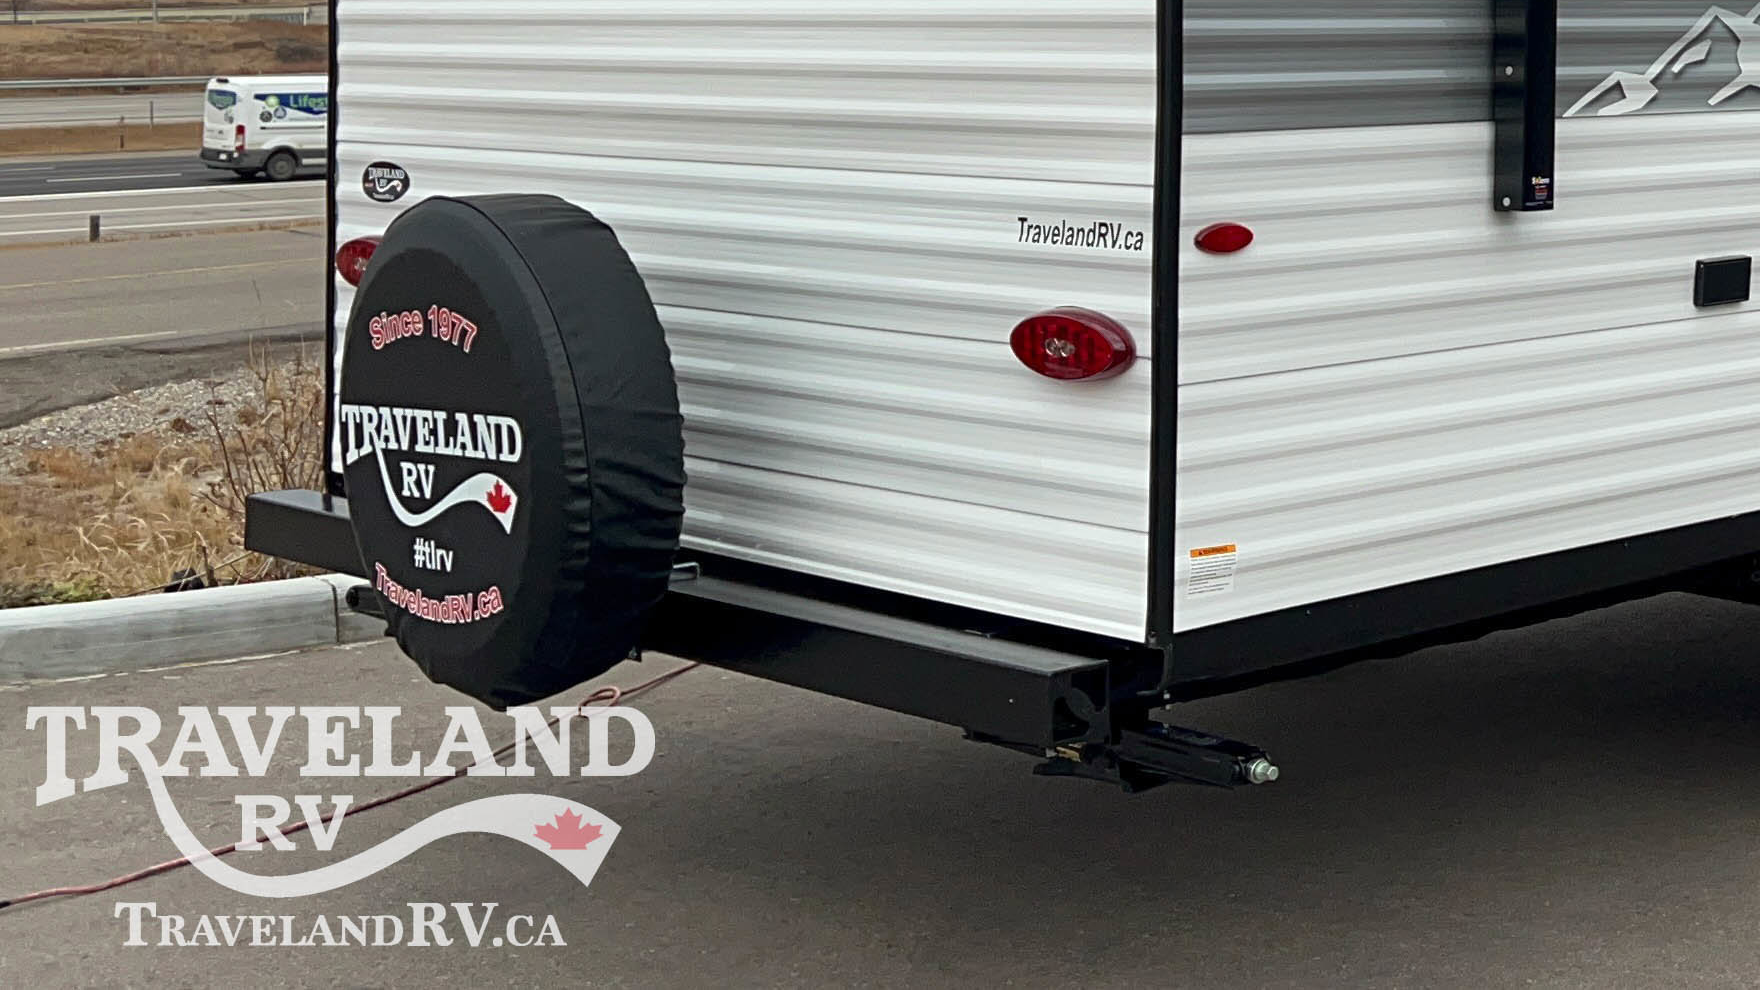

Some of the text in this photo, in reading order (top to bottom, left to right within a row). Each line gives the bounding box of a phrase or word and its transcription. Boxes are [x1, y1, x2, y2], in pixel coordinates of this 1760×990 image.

[1017, 217, 1145, 251] TravelandRV.ca
[369, 305, 478, 353] Since 1977
[341, 404, 522, 466] TRAVELAND
[400, 462, 435, 499] RV
[413, 537, 454, 572] #tlrv
[375, 562, 504, 624] TravelandRV.ca
